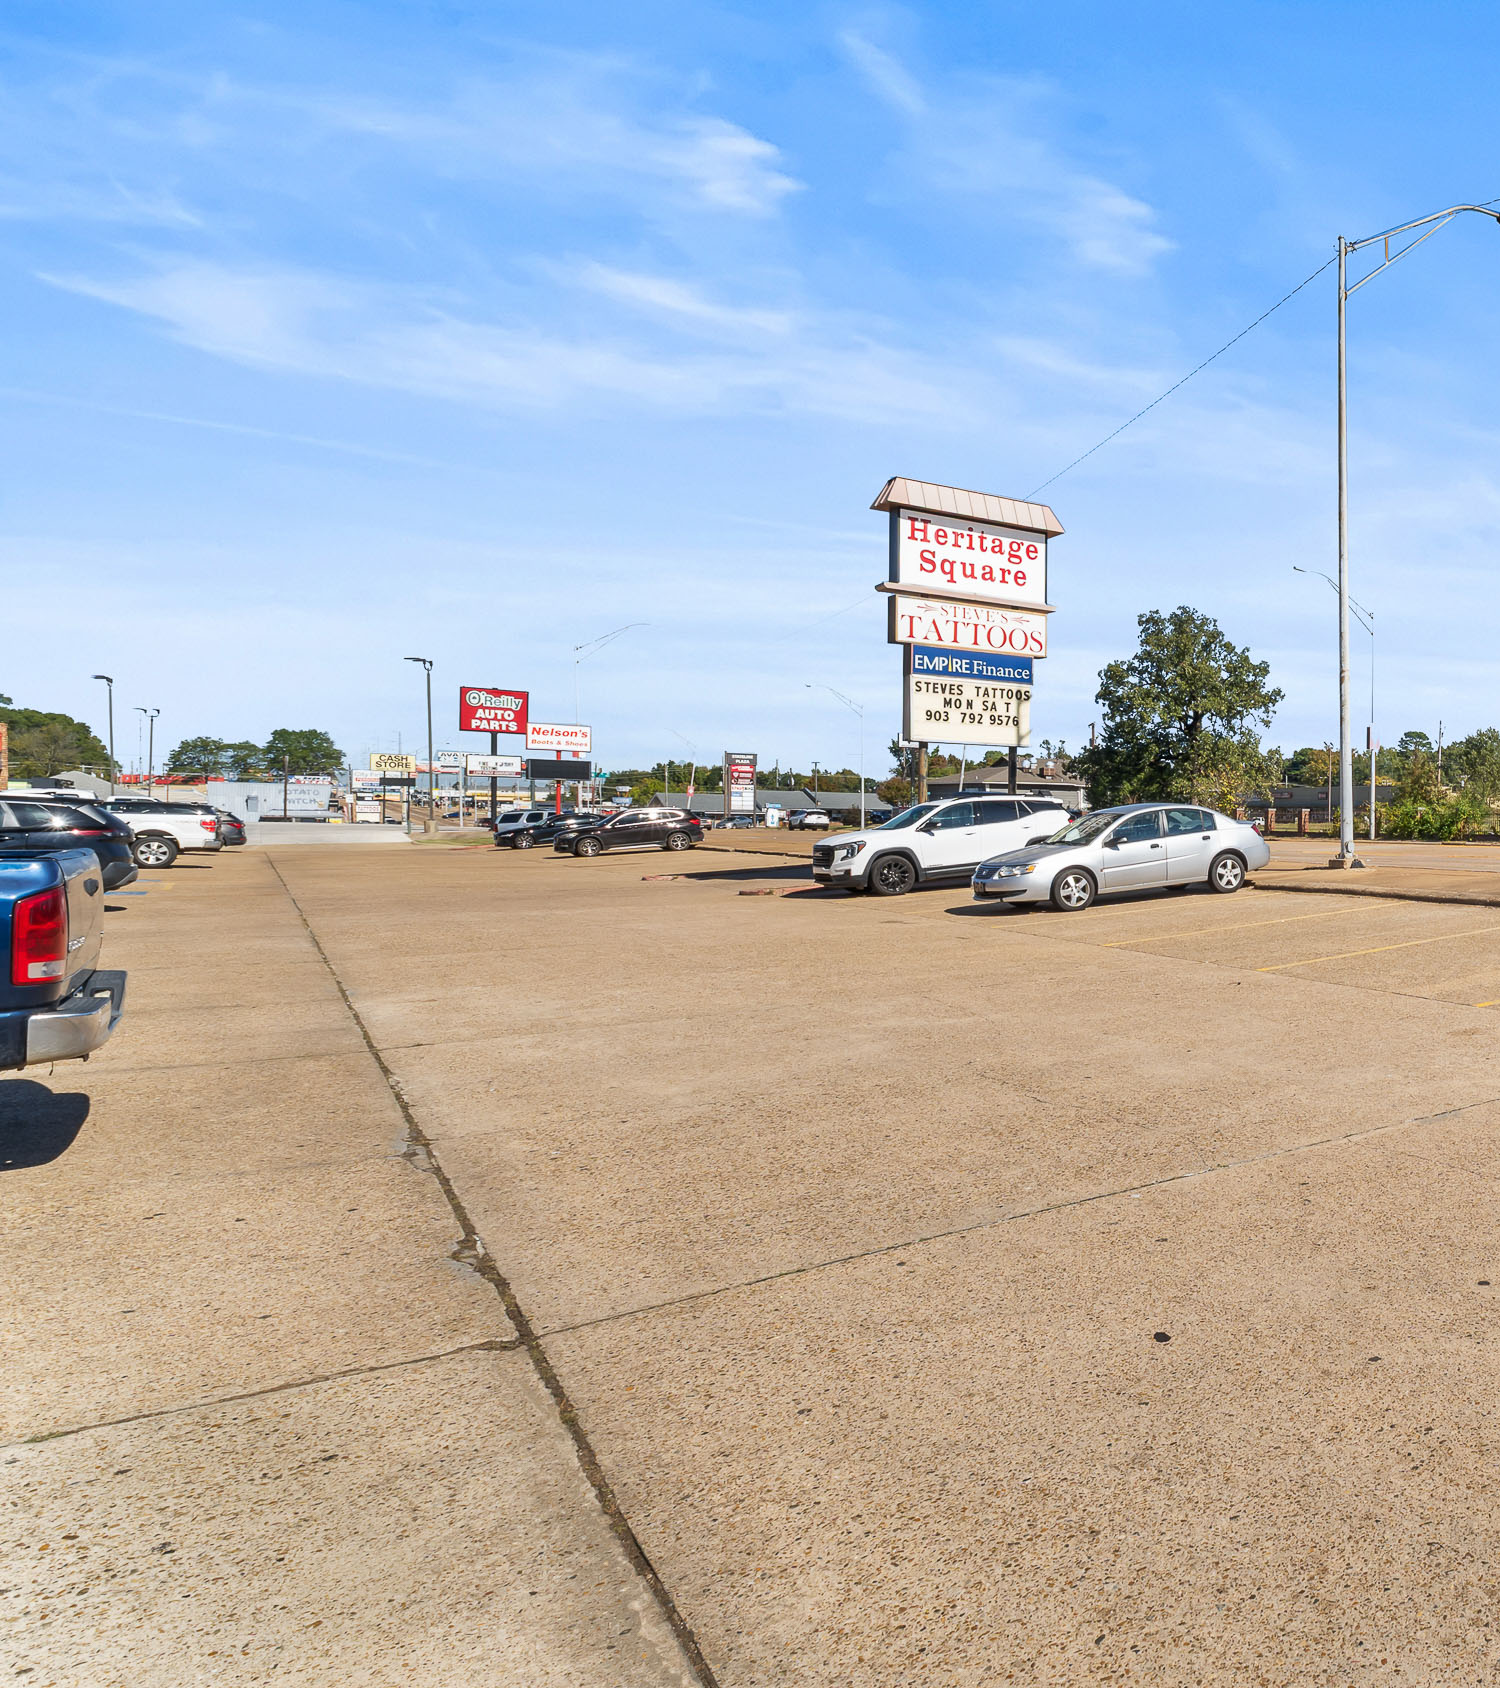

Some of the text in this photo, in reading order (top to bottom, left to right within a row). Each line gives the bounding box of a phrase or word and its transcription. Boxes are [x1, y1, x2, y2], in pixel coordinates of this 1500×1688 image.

[907, 516, 1039, 565] Heritage
[919, 549, 1027, 587] Square
[940, 605, 1009, 624] STEVE'S
[900, 614, 1043, 653] TATTOOS
[914, 654, 1030, 679] EMPIRE Finance
[467, 691, 521, 710] O'Reilly
[915, 681, 1031, 701] STEVES TATTOOS
[475, 709, 515, 720] AUTO
[925, 710, 1019, 727] 903 792 9576
[471, 719, 518, 731] PARTS
[531, 727, 588, 738] Nelson's
[375, 761, 411, 769] STORE
